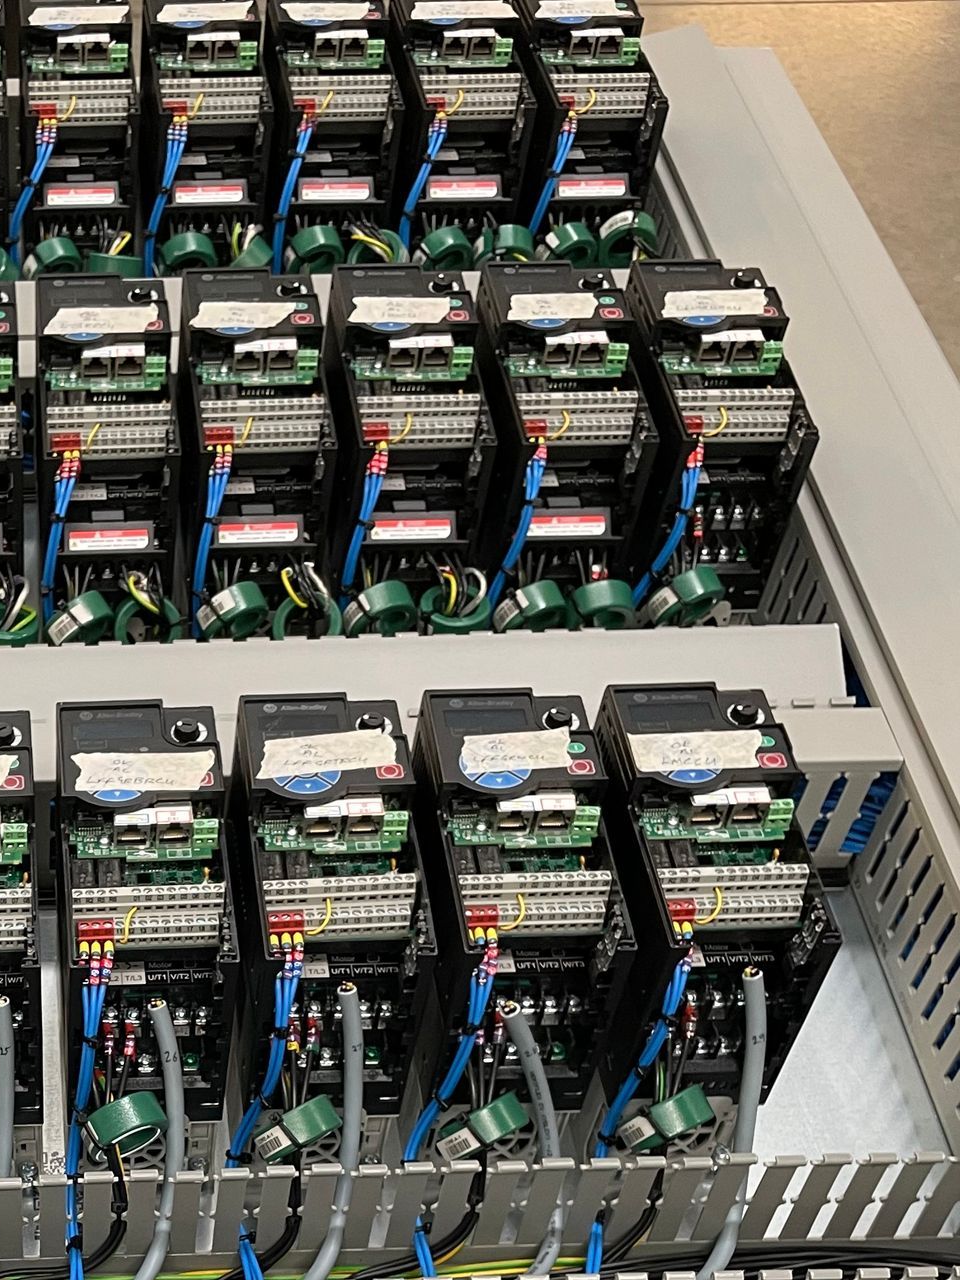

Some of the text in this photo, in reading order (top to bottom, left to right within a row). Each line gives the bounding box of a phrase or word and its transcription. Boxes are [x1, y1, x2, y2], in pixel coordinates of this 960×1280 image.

[377, 965, 399, 973] W/T3
[517, 961, 536, 969] U/T1
[563, 960, 585, 968] W/T3
[125, 972, 189, 981] T/L3 U/T1 V/T2
[164, 1051, 178, 1063] 26
